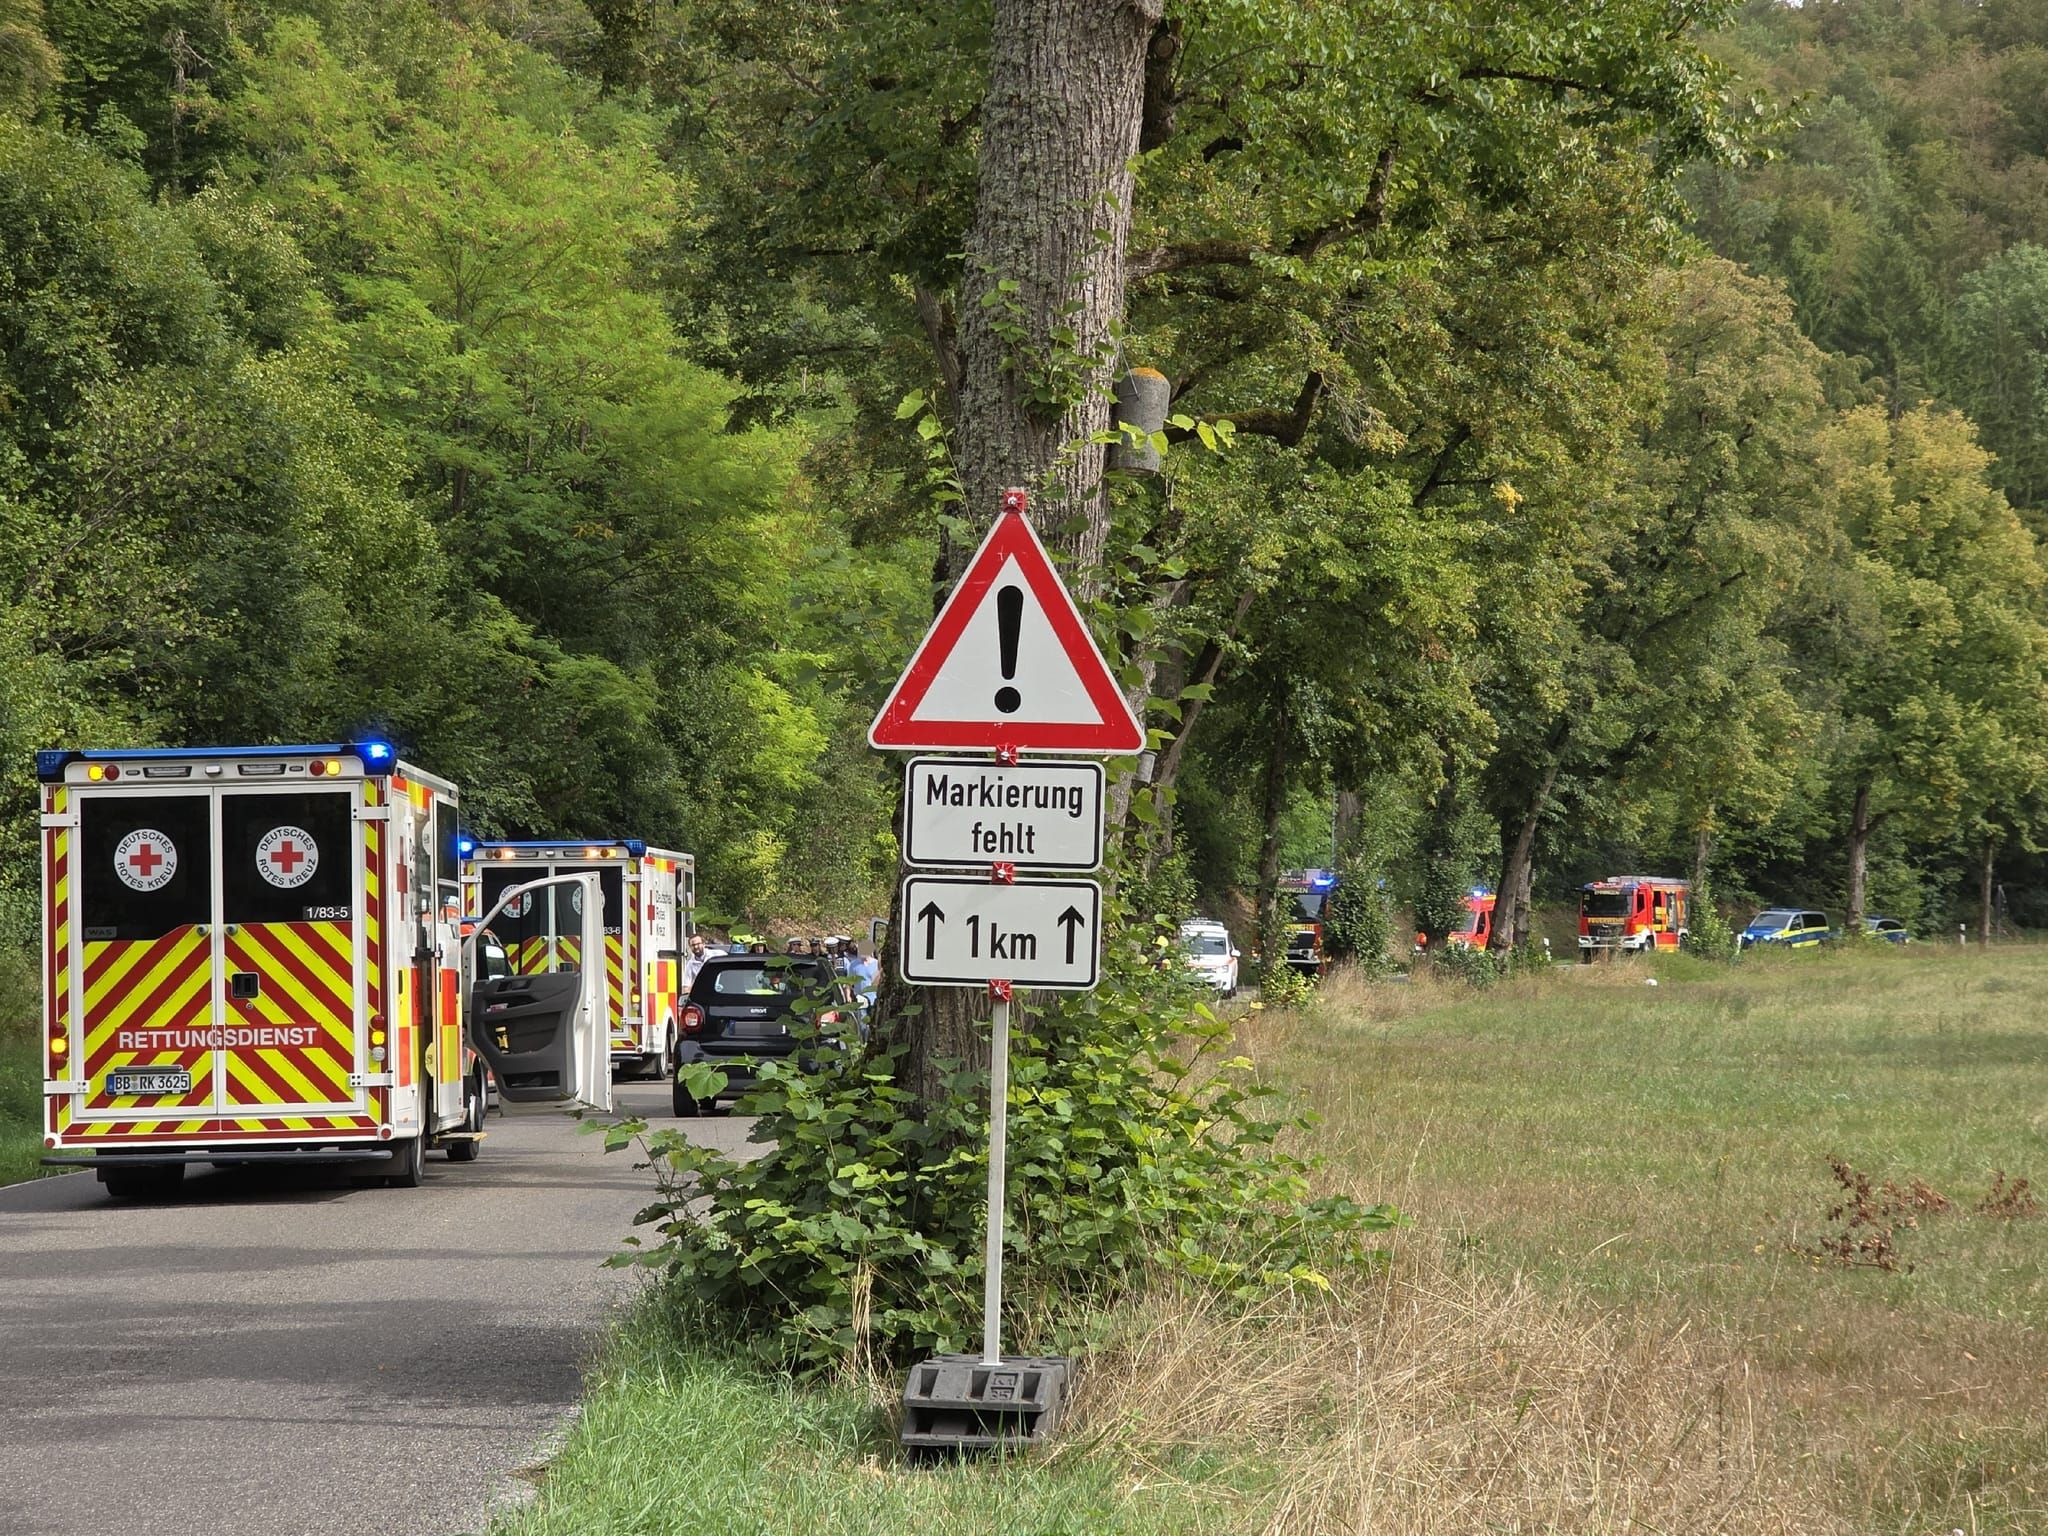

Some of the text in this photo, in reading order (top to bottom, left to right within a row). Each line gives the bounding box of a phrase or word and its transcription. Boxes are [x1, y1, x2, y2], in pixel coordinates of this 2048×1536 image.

[926, 774, 1084, 819] Markierung
[118, 831, 174, 855] DEUTSCHES
[260, 828, 315, 851] DEUTSCHES
[971, 821, 1036, 855] fehlt
[117, 860, 175, 889] ROTES KREUZ
[258, 858, 317, 886] ROTES KREUZ
[306, 906, 349, 919] 1/83-5
[966, 914, 1037, 960] 1 km
[119, 1027, 318, 1049] RETTUNGSDIENST
[115, 1075, 188, 1090] BB RK 3625
